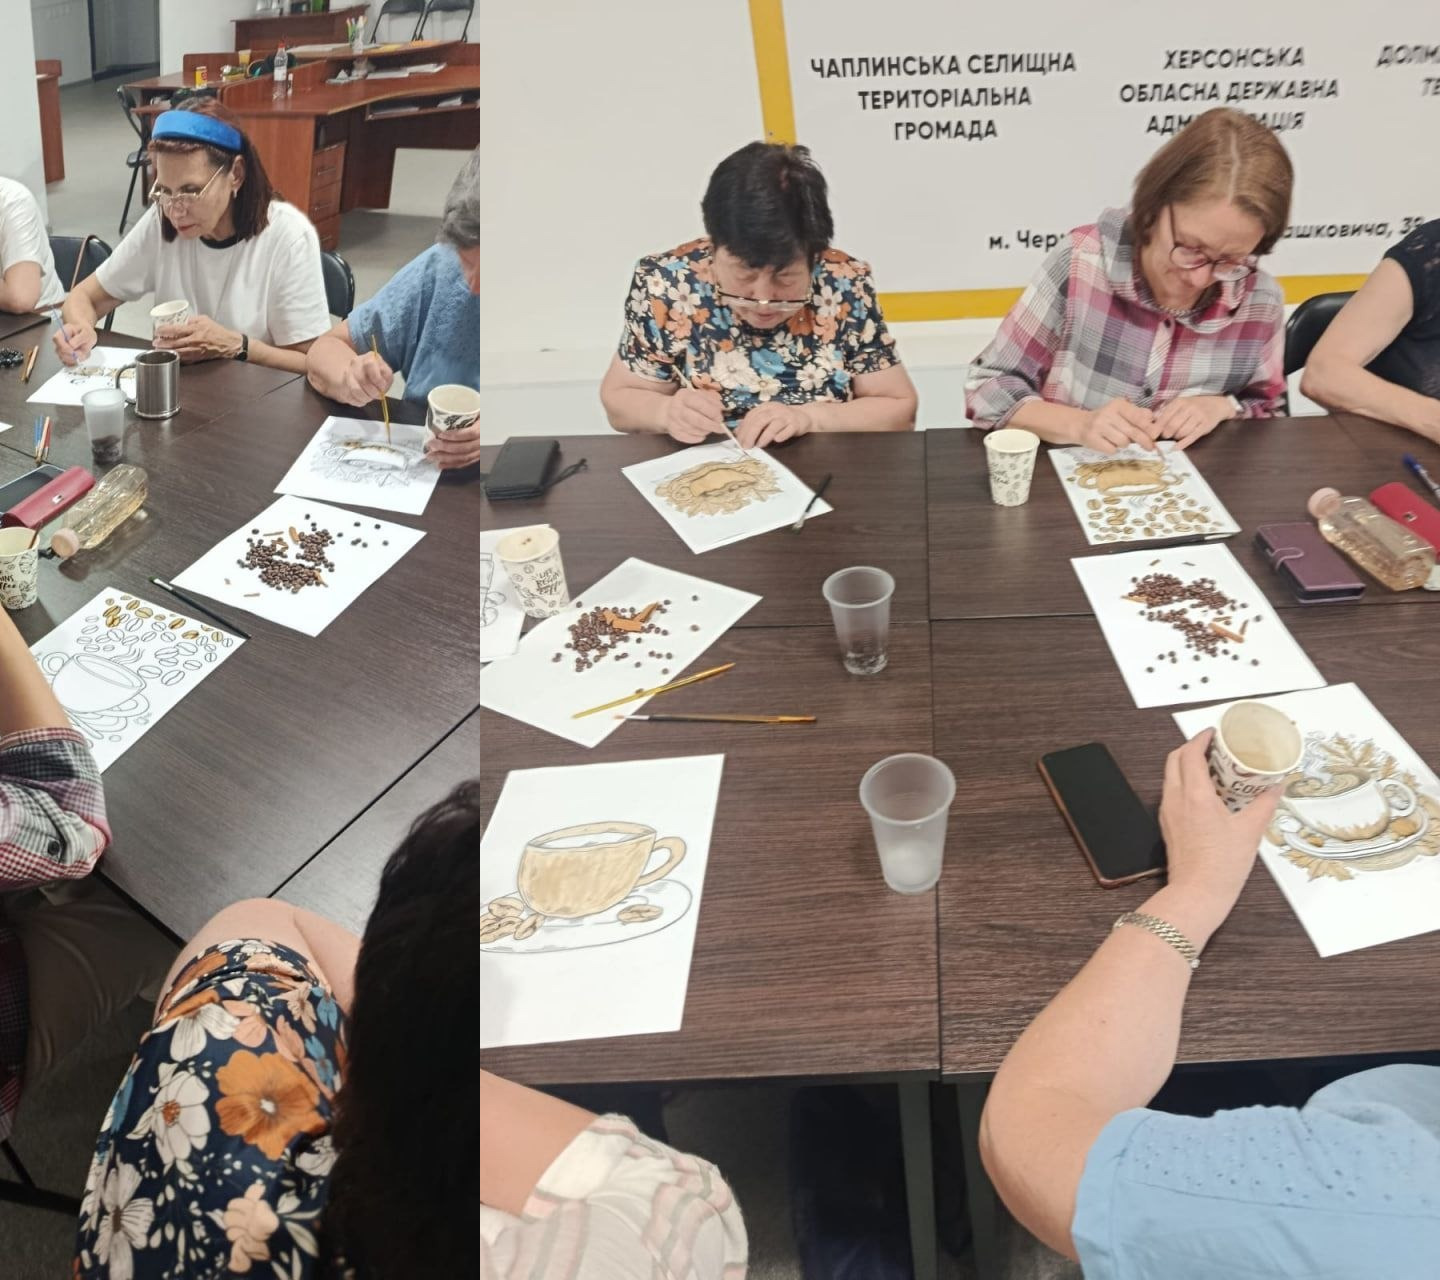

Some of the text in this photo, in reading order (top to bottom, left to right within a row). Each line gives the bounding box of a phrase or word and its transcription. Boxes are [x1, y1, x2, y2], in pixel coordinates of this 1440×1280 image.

[810, 52, 1077, 78] ЧАПЛИНСЬКА СЕЛИЩНА
[1163, 47, 1305, 69] ХЕРСОНСЬКА
[858, 87, 1032, 110] ТЕРИТОРІАЛЬНА
[1120, 79, 1339, 103] ОБЛАСНА ДЕРЖАВНА
[894, 120, 998, 141] ГРОМАДА
[988, 236, 1010, 250] м.
[1016, 229, 1065, 252] Чер
[1282, 222, 1393, 240] ашковича,
